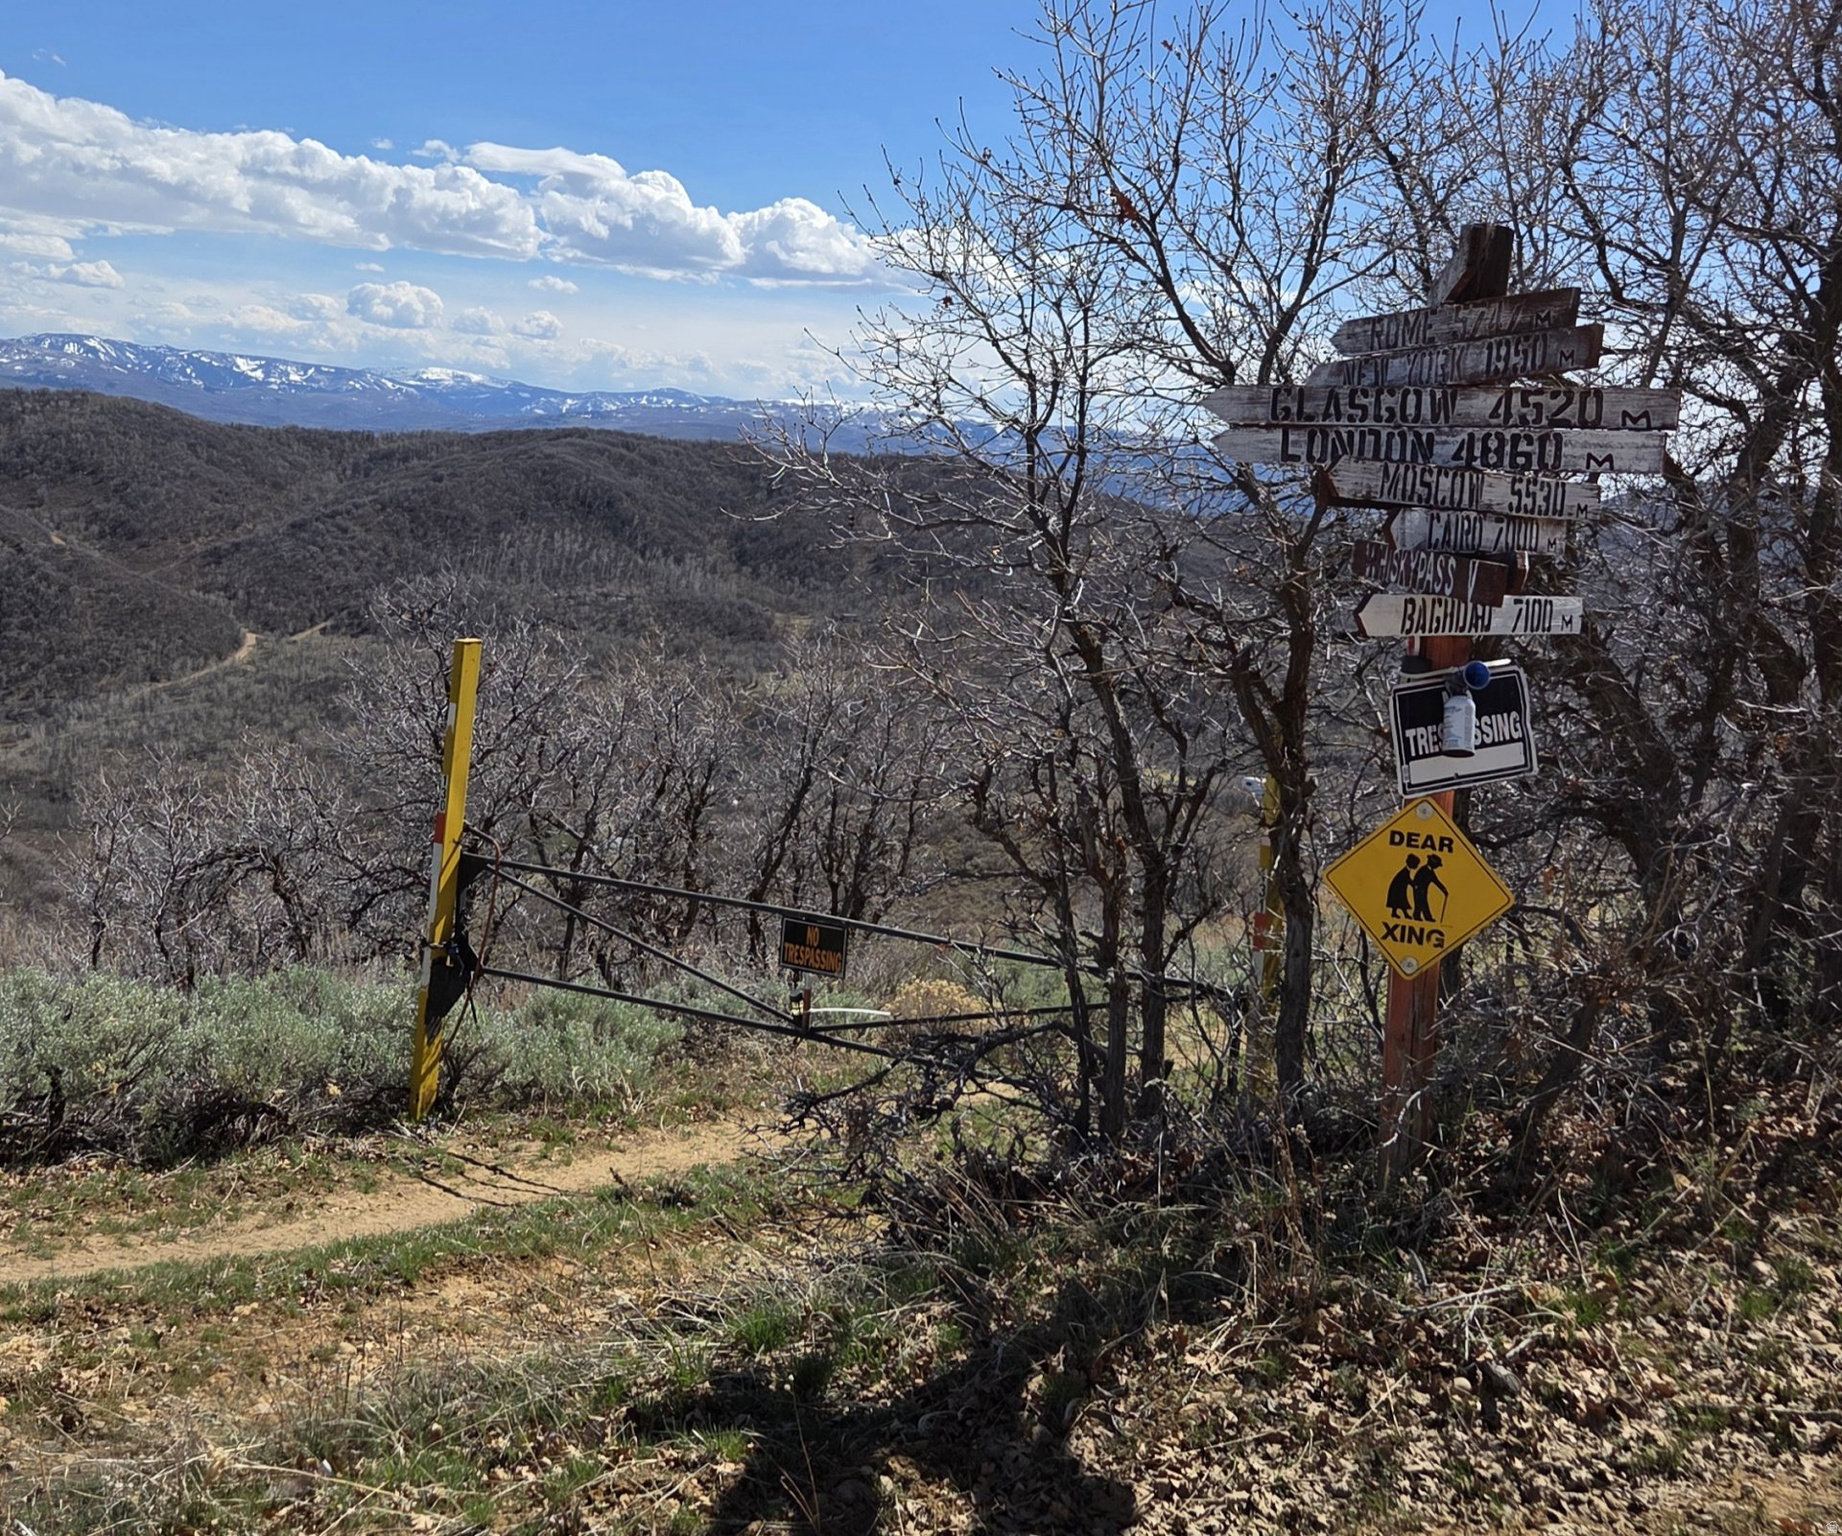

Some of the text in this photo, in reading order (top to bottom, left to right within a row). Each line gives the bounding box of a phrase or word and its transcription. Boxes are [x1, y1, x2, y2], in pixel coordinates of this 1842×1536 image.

[1370, 309, 1438, 352] ROME
[1535, 309, 1552, 328] M
[1342, 333, 1575, 386] NEW YORK 1950 M
[1270, 387, 1652, 428] GLASGOW 4520 M
[1281, 429, 1615, 471] LONDON 4860 M
[1380, 462, 1589, 519] MOSCOW 5530 M
[1427, 511, 1557, 553] CAIRO 7000 M
[1401, 597, 1574, 635] BAGHDAD 7100 M
[1389, 829, 1455, 854] DEAR
[806, 926, 820, 946] NO
[1381, 921, 1446, 950] XING
[784, 942, 842, 971] TRESPASSING
